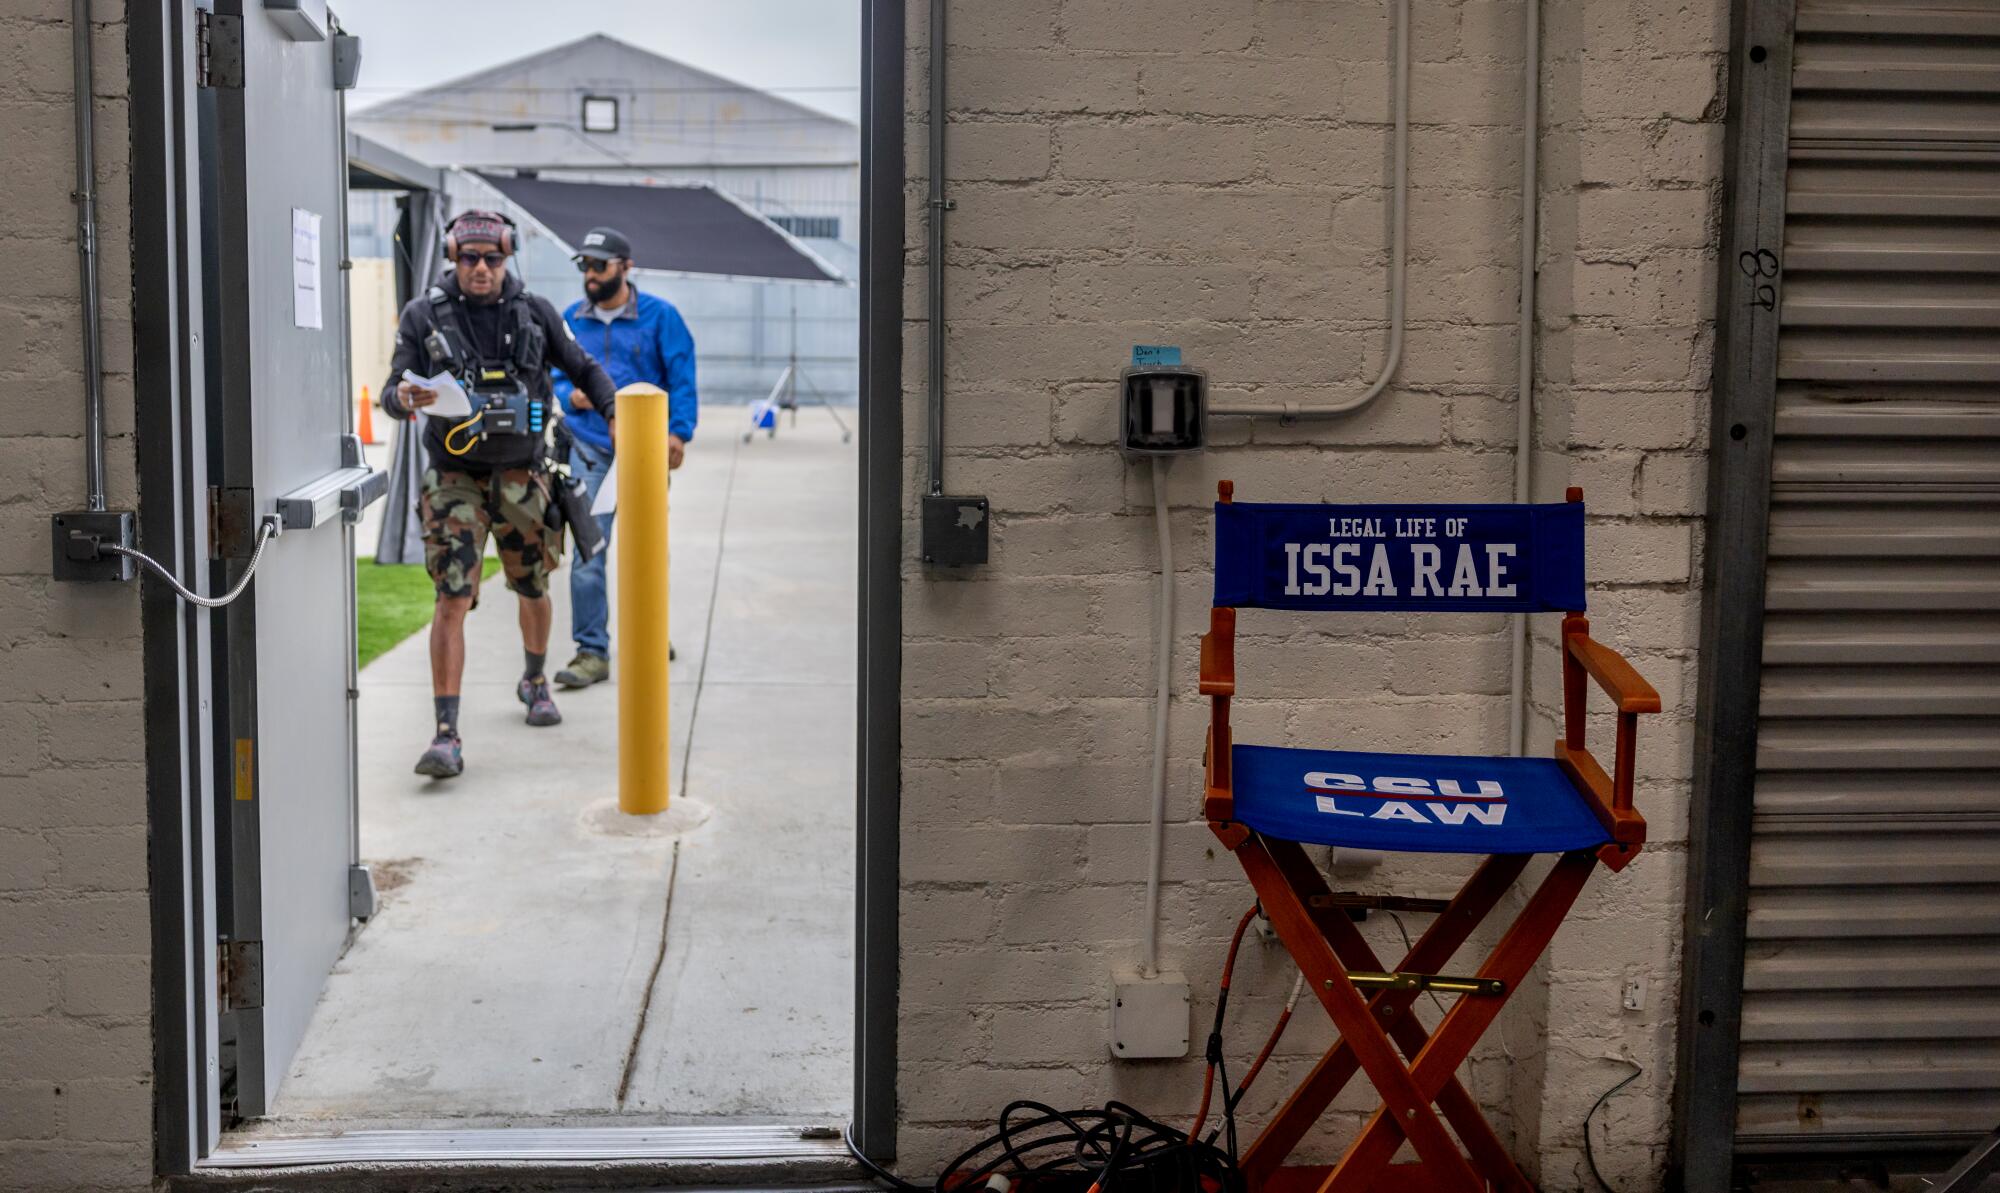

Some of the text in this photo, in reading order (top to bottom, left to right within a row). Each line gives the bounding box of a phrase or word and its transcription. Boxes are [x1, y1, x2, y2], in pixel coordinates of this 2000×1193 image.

[1135, 345, 1161, 356] Don't
[1329, 518, 1468, 538] LEGAL LIFE OF
[1284, 543, 1517, 597] ISSA RAE
[1303, 771, 1504, 798] GSU
[1315, 795, 1508, 826] LAW
